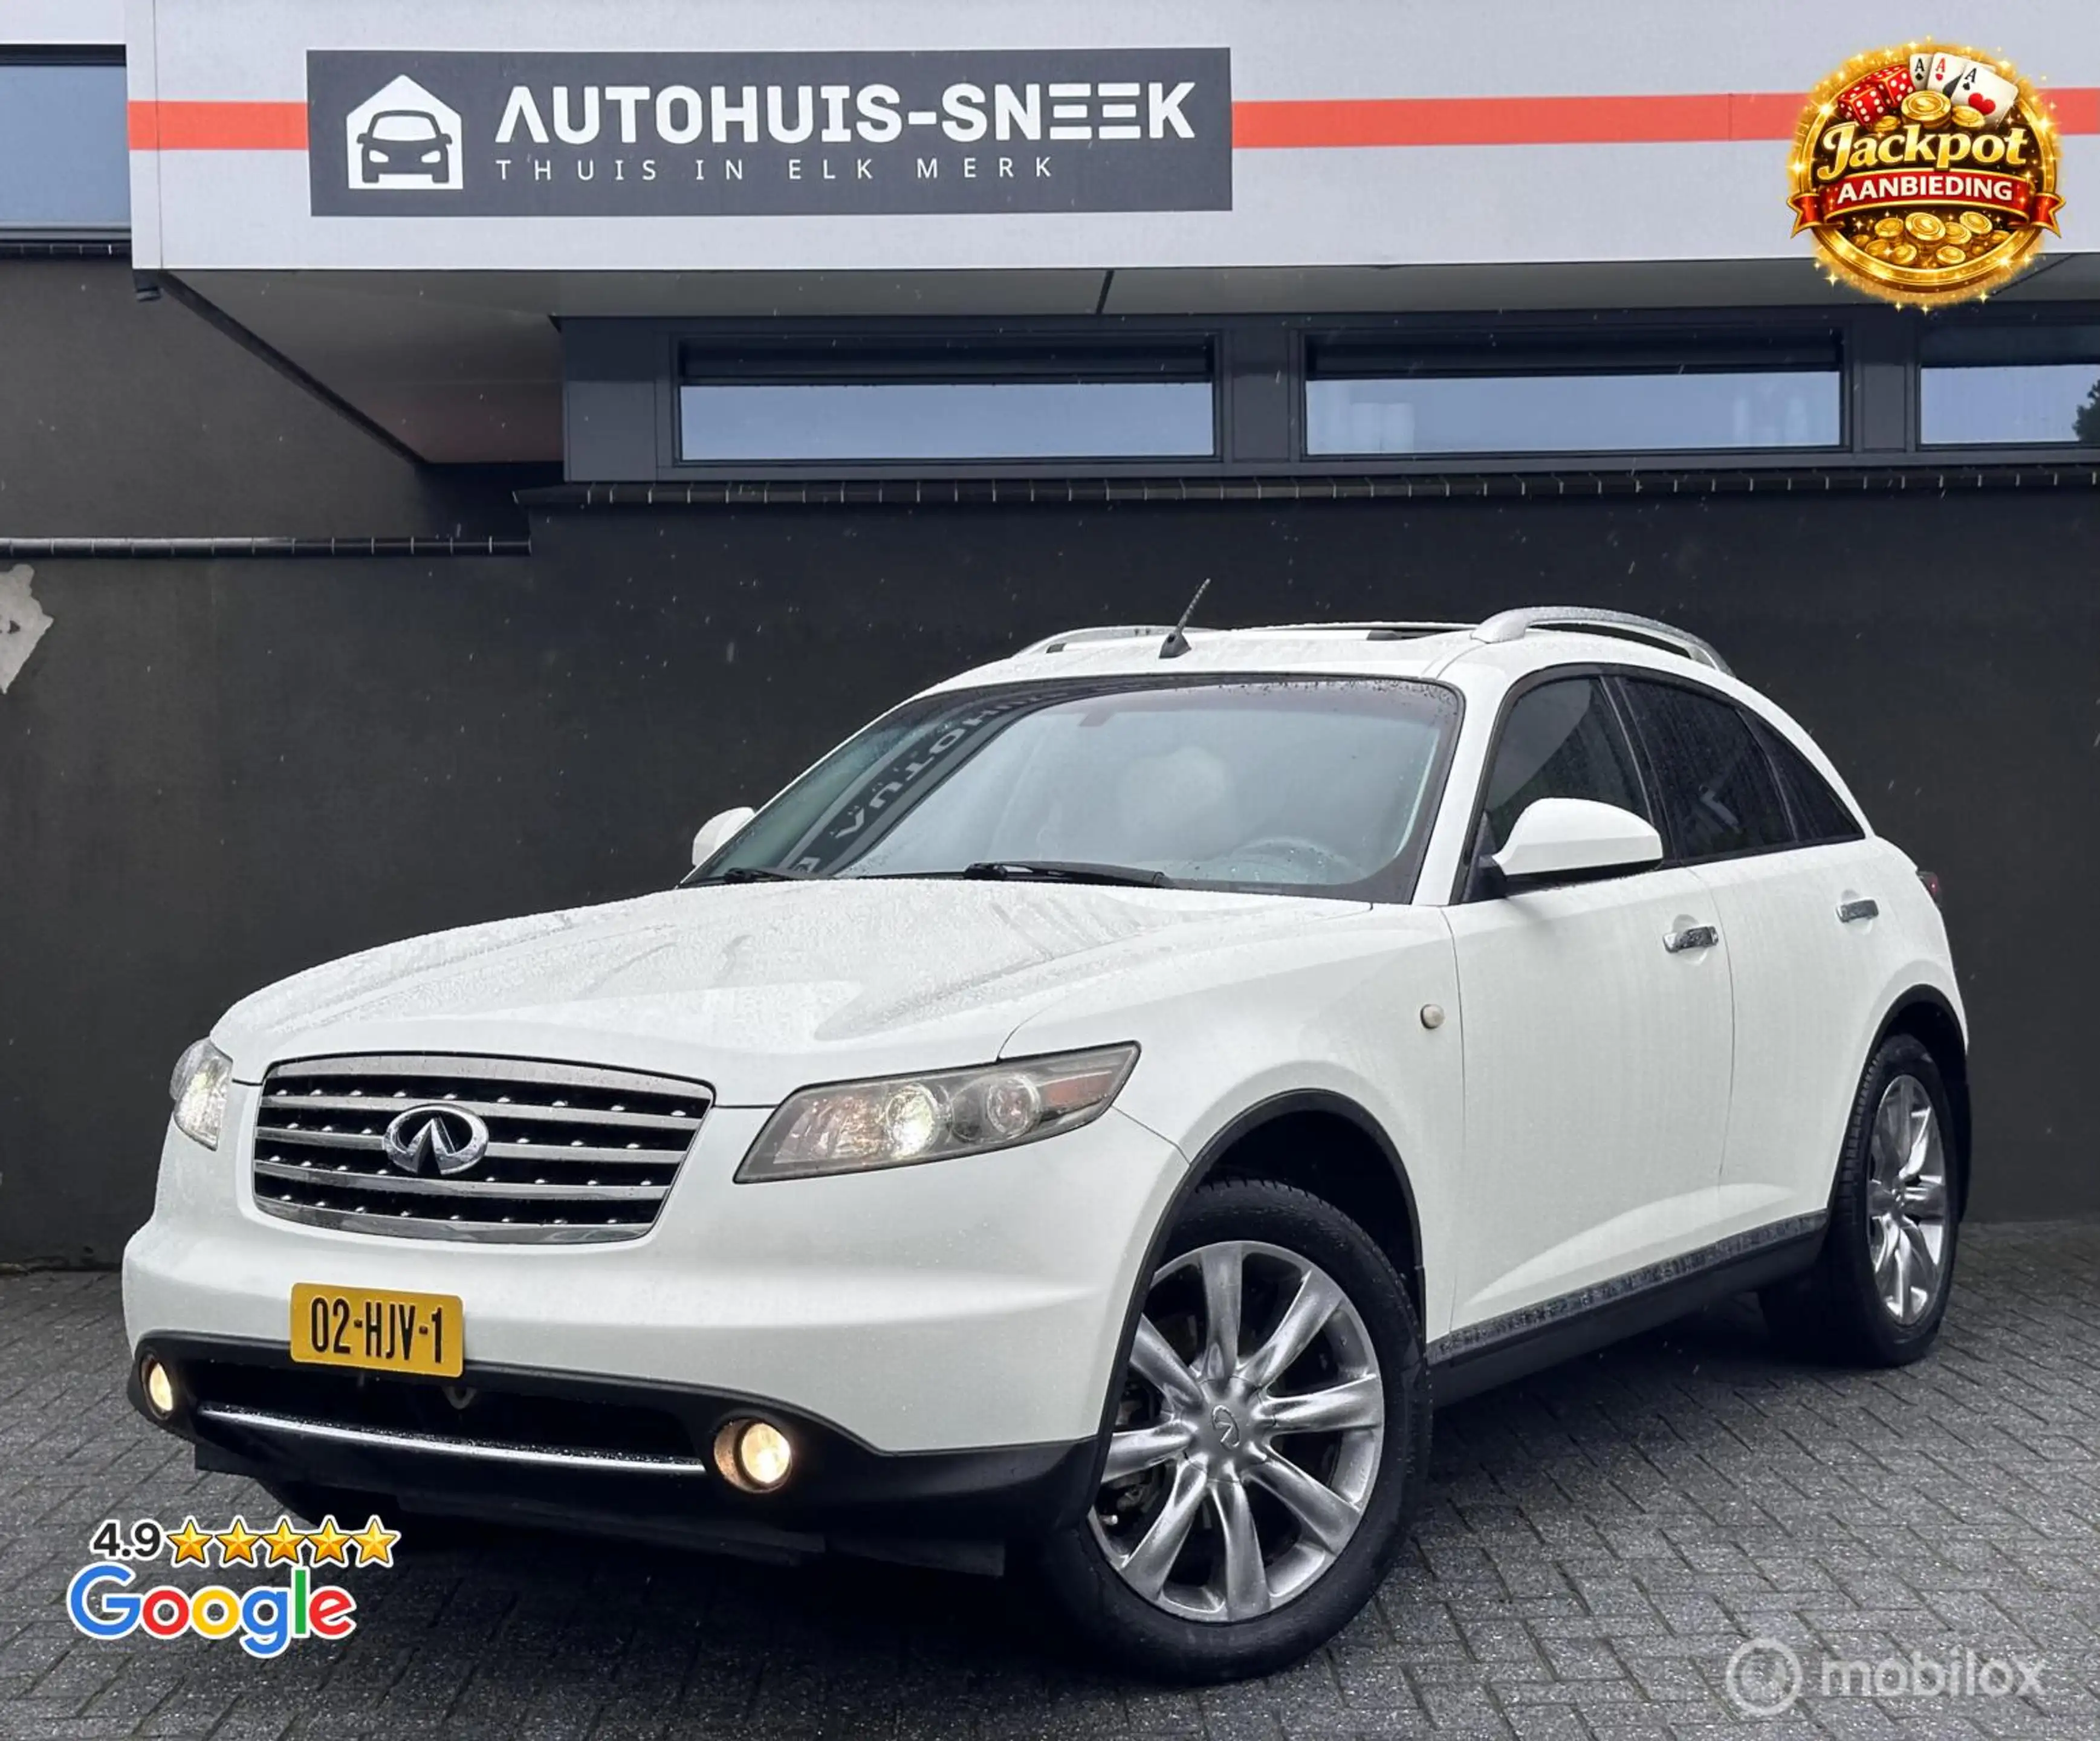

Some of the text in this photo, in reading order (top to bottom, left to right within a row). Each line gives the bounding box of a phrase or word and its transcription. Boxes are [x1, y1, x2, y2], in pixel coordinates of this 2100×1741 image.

[494, 82, 1196, 145] AUTOHUIS-SNEEK
[495, 157, 1051, 181] THUIS IN ELK MERK
[311, 1297, 442, 1364] 02-HJV-1
